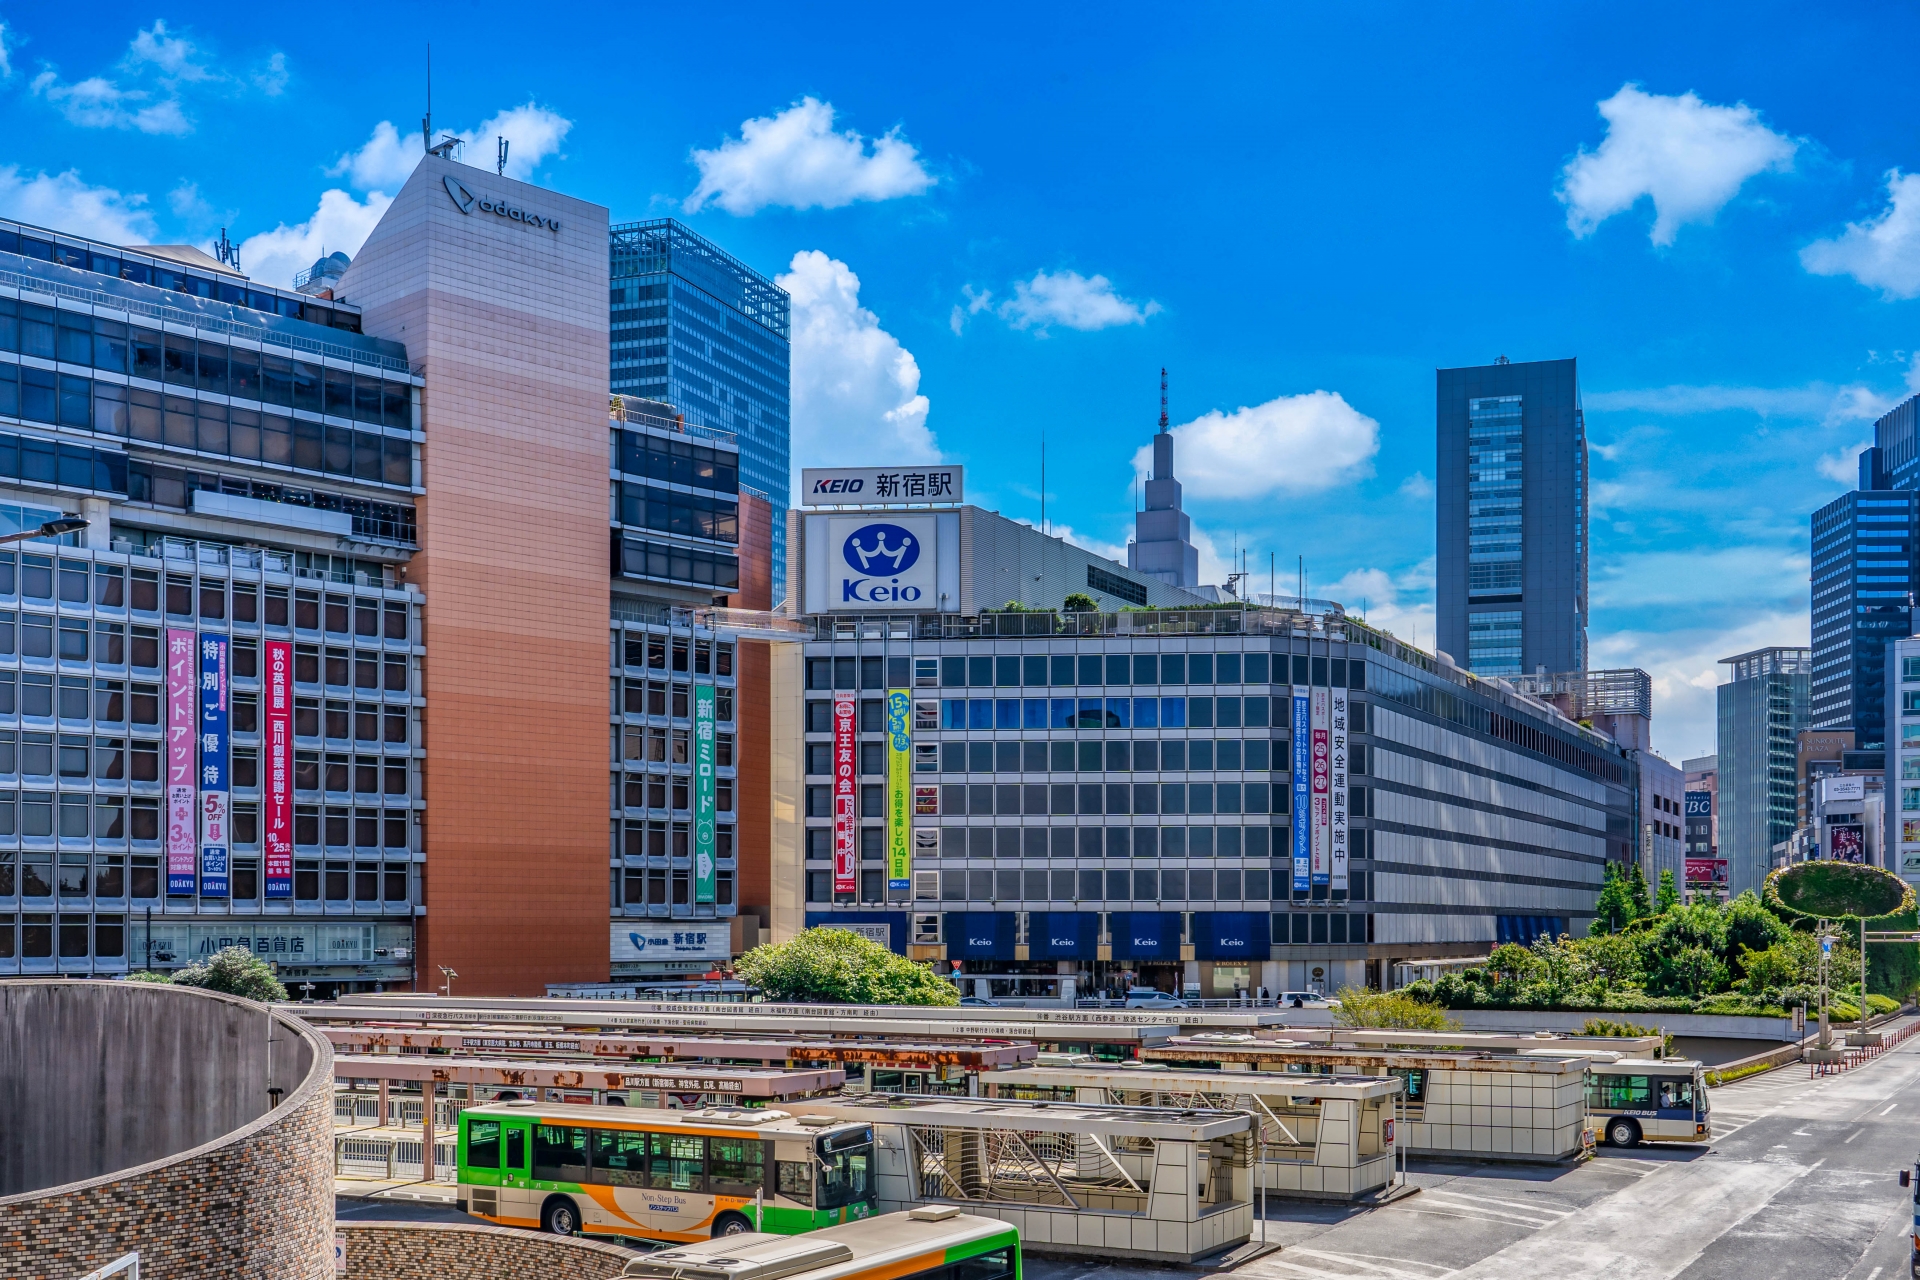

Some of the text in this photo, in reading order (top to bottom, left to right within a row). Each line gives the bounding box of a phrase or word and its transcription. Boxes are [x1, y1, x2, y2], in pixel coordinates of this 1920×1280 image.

[478, 196, 561, 232] odakyu
[813, 472, 952, 498] KEIO 新宿駅
[842, 578, 922, 602] Keio
[272, 648, 285, 709] 秋の英国展
[171, 637, 188, 782] ポイントアップ
[202, 640, 219, 784] 特別ご優待
[698, 698, 713, 813] 新宿ミロード
[839, 717, 852, 794] 京王友の会
[272, 720, 286, 830] 西川創業感謝セール
[1333, 697, 1346, 863] 地域安全運動実施中
[205, 794, 226, 814] 5%
[846, 798, 854, 875] ご入会キャンペーン
[892, 789, 906, 878] お得を楽しむ14日間
[170, 878, 194, 888] ODAKYU
[203, 880, 227, 891] ODAKYU
[267, 882, 290, 891] ODAKYU
[200, 936, 305, 954] 小田急百貨店
[332, 939, 358, 949] ODAKYU
[647, 932, 707, 946] 小田急 新宿駅
[969, 938, 992, 946] Keio
[1051, 938, 1075, 946] Keio
[1134, 937, 1158, 946] Keio
[1220, 938, 1244, 946] Keio
[675, 1195, 687, 1204] Bus
